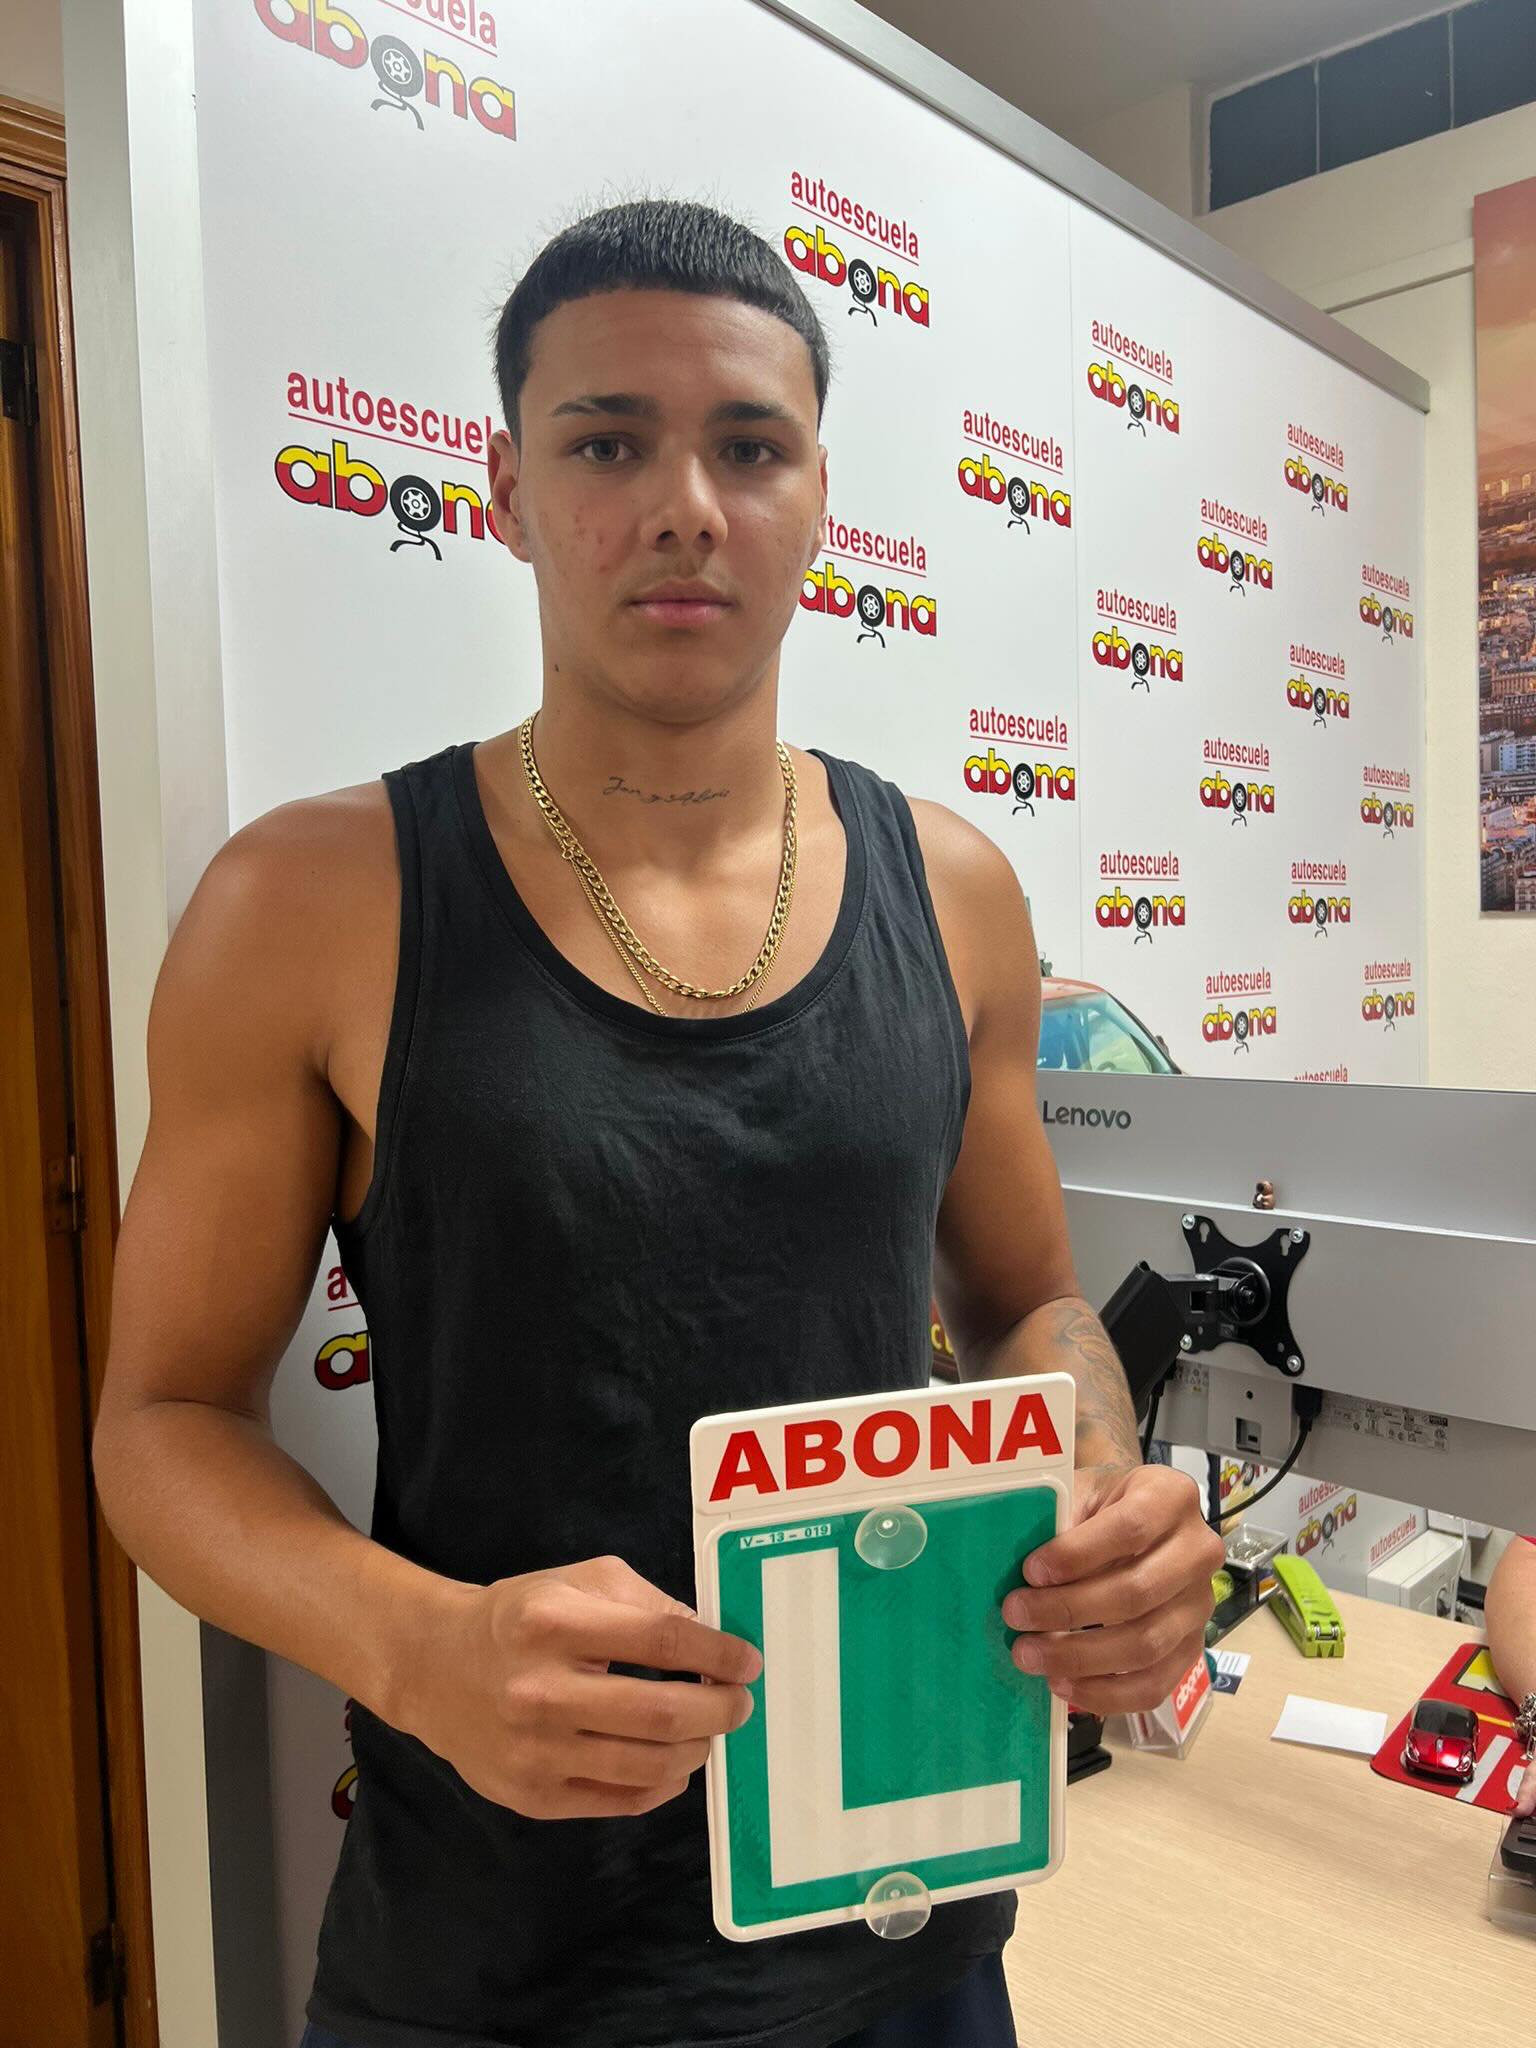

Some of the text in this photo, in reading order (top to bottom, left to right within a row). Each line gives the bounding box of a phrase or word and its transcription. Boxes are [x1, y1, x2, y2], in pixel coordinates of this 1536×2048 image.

[791, 170, 919, 260] autoescuela
[784, 225, 929, 327] abona
[1091, 319, 1173, 380] autoescuela
[287, 372, 492, 453] autoescuel
[1087, 361, 1179, 434] abona
[963, 408, 1063, 469] autoescuela
[1287, 422, 1344, 467] autoescuela
[274, 438, 506, 546] abon
[957, 453, 1072, 528] abona
[1284, 455, 1348, 512] abona
[1200, 497, 1268, 541] autoescuela
[828, 515, 926, 570] toescuela
[1197, 533, 1273, 590] abona
[799, 561, 937, 637] abona
[1361, 562, 1410, 598] autoescuela
[1096, 588, 1177, 629] autoescuela
[1359, 593, 1414, 640] abona
[1092, 625, 1183, 682] abona
[1290, 643, 1345, 675] autoescuela
[1287, 674, 1350, 719] abona
[969, 706, 1068, 743] autoescuela
[963, 747, 1076, 801] abona
[1203, 736, 1270, 767] autoescuela
[1200, 770, 1275, 814] abona
[1363, 764, 1410, 788] autoescuela
[1360, 792, 1414, 828] abona
[1100, 850, 1179, 877] autoescuela
[1291, 859, 1346, 882] autoescuela
[1095, 886, 1186, 929] abona
[1288, 889, 1351, 926] abona
[1205, 967, 1271, 994] autoescuela
[1364, 957, 1411, 981] autoescuela
[1202, 1003, 1277, 1043] abona
[1361, 988, 1415, 1021] abona
[1042, 1101, 1131, 1129] Lenovo
[709, 1393, 1063, 1502] ABONA
[1296, 1493, 1357, 1556] abona
[1370, 1513, 1416, 1561] autoescuela
[761, 1547, 1021, 1888] L
